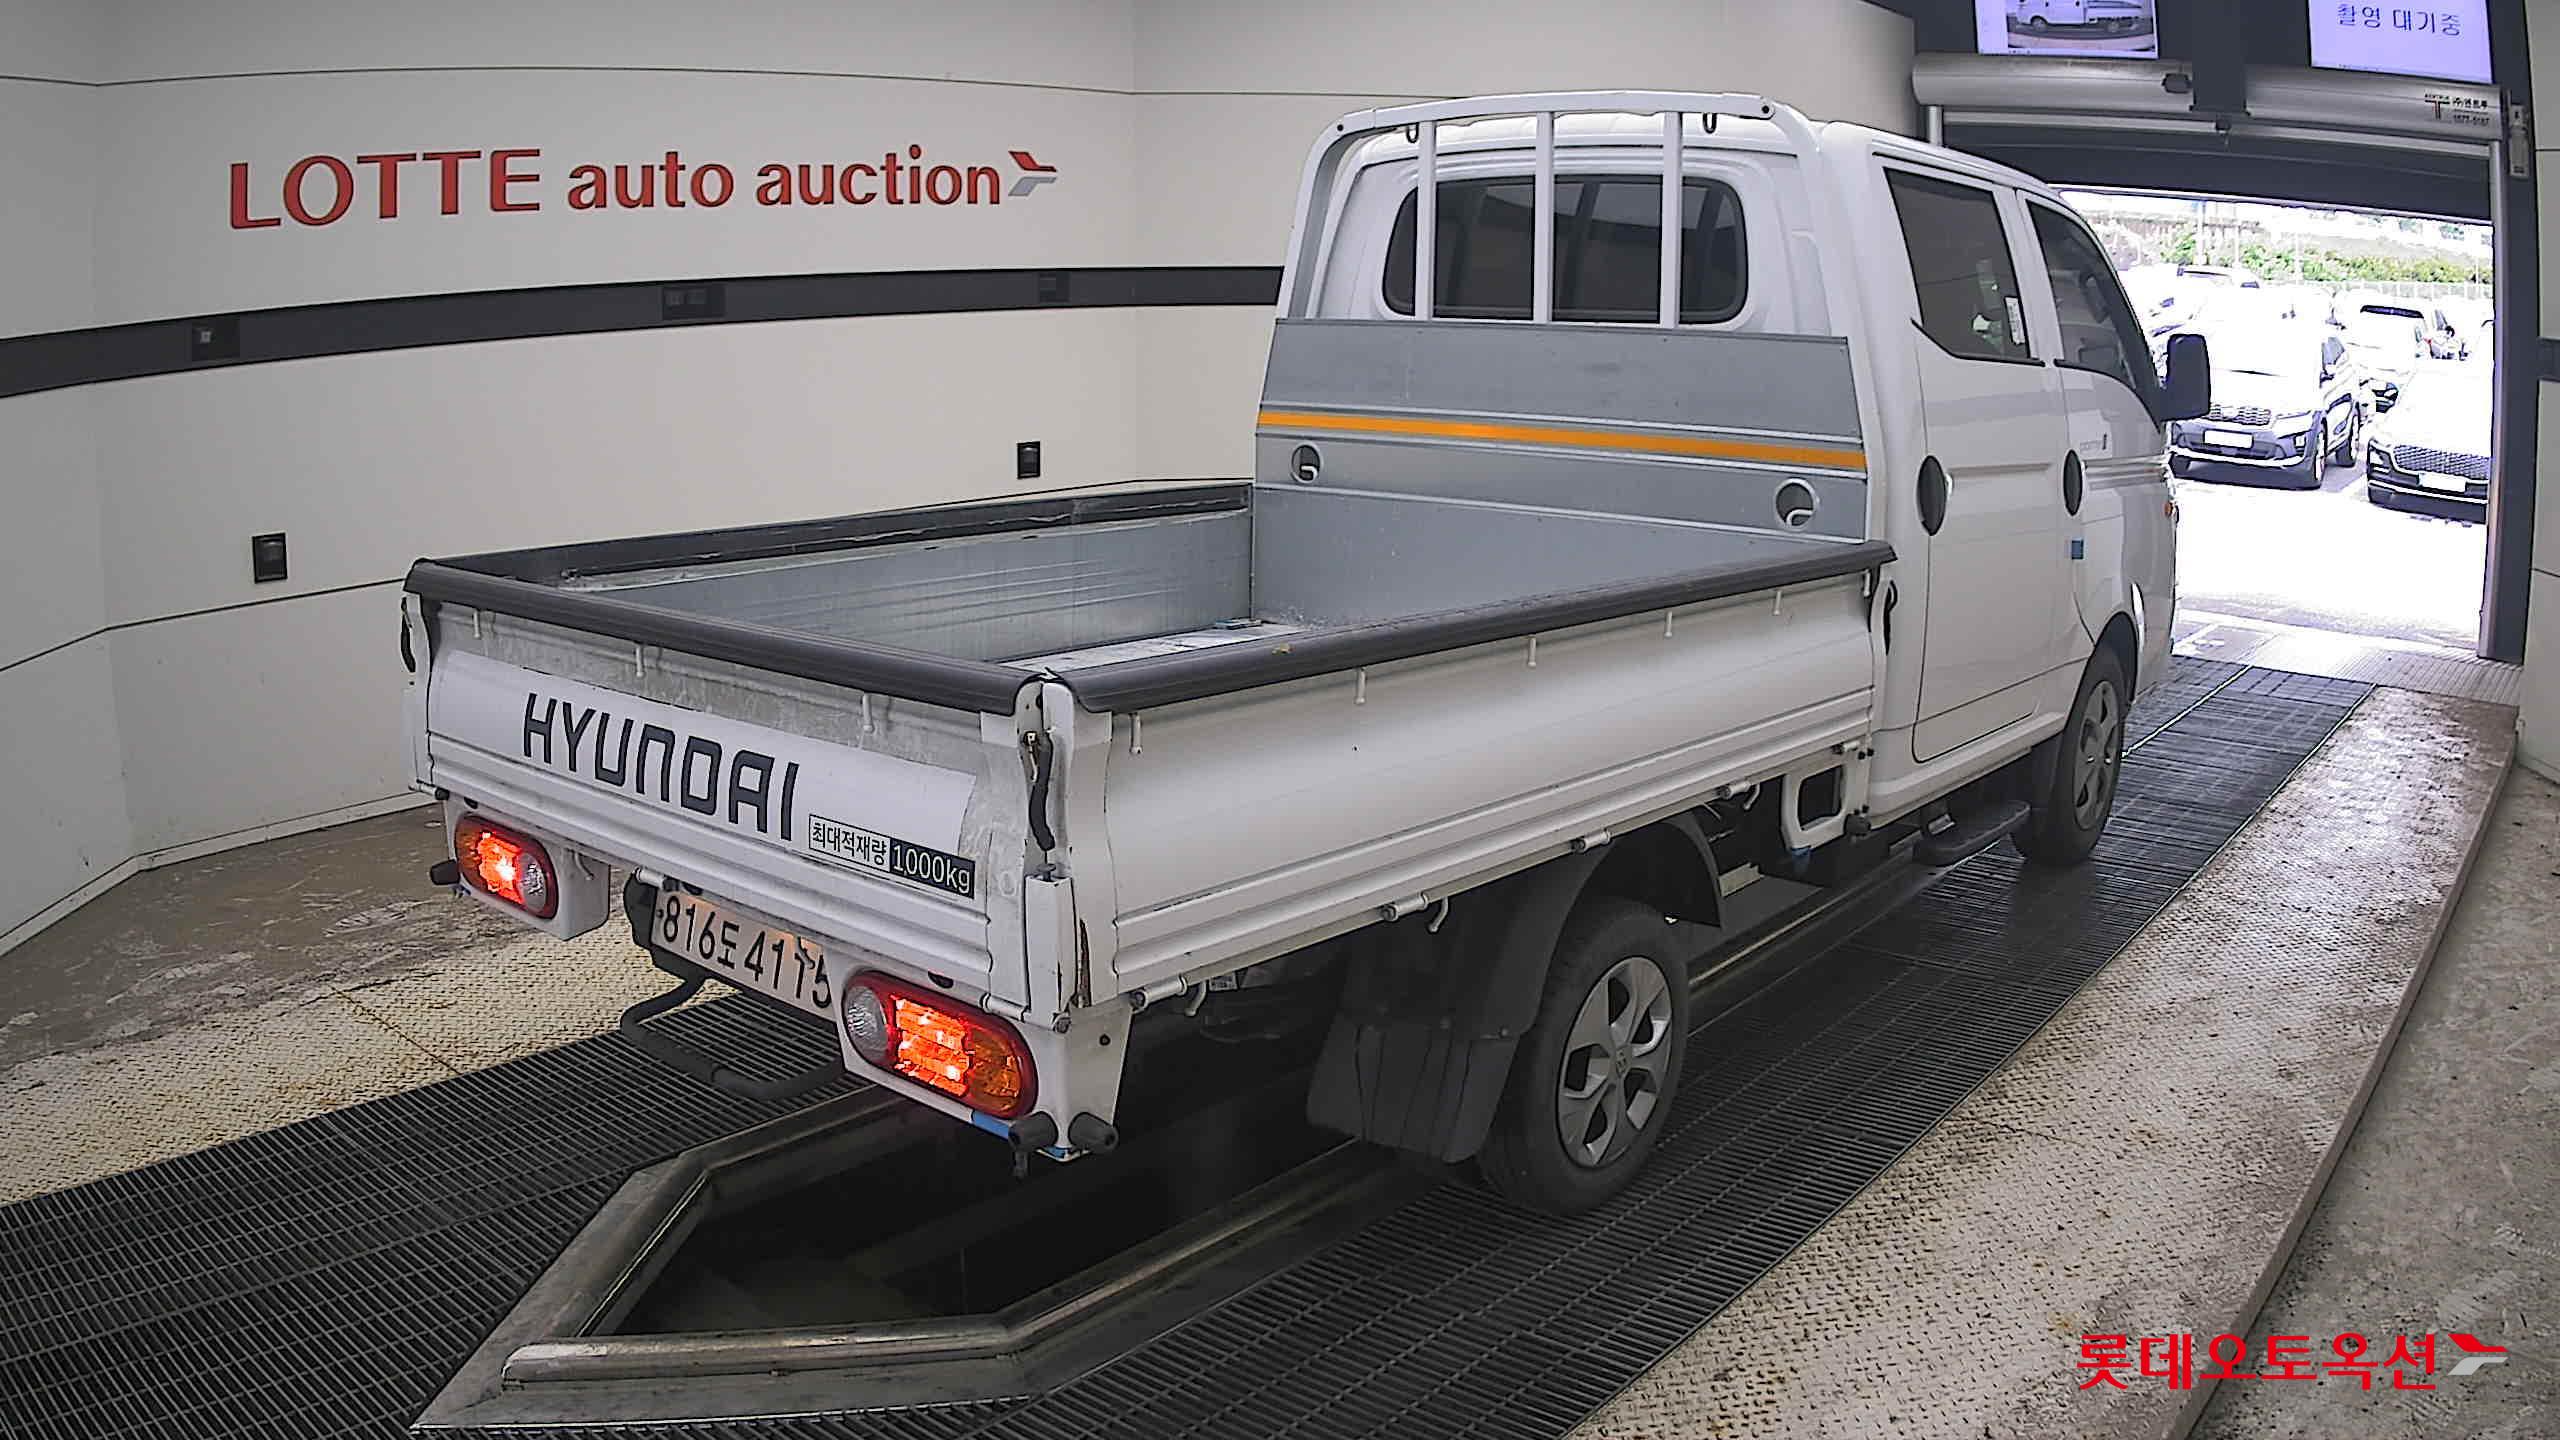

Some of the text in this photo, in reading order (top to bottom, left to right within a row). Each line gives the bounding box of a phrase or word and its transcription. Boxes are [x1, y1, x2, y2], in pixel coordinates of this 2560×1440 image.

[2337, 3, 2461, 36] 촬영 대기중
[229, 144, 1001, 230] LOTTE auto auction
[523, 692, 800, 842] HYUNDAI
[812, 822, 887, 866] 최대적재량
